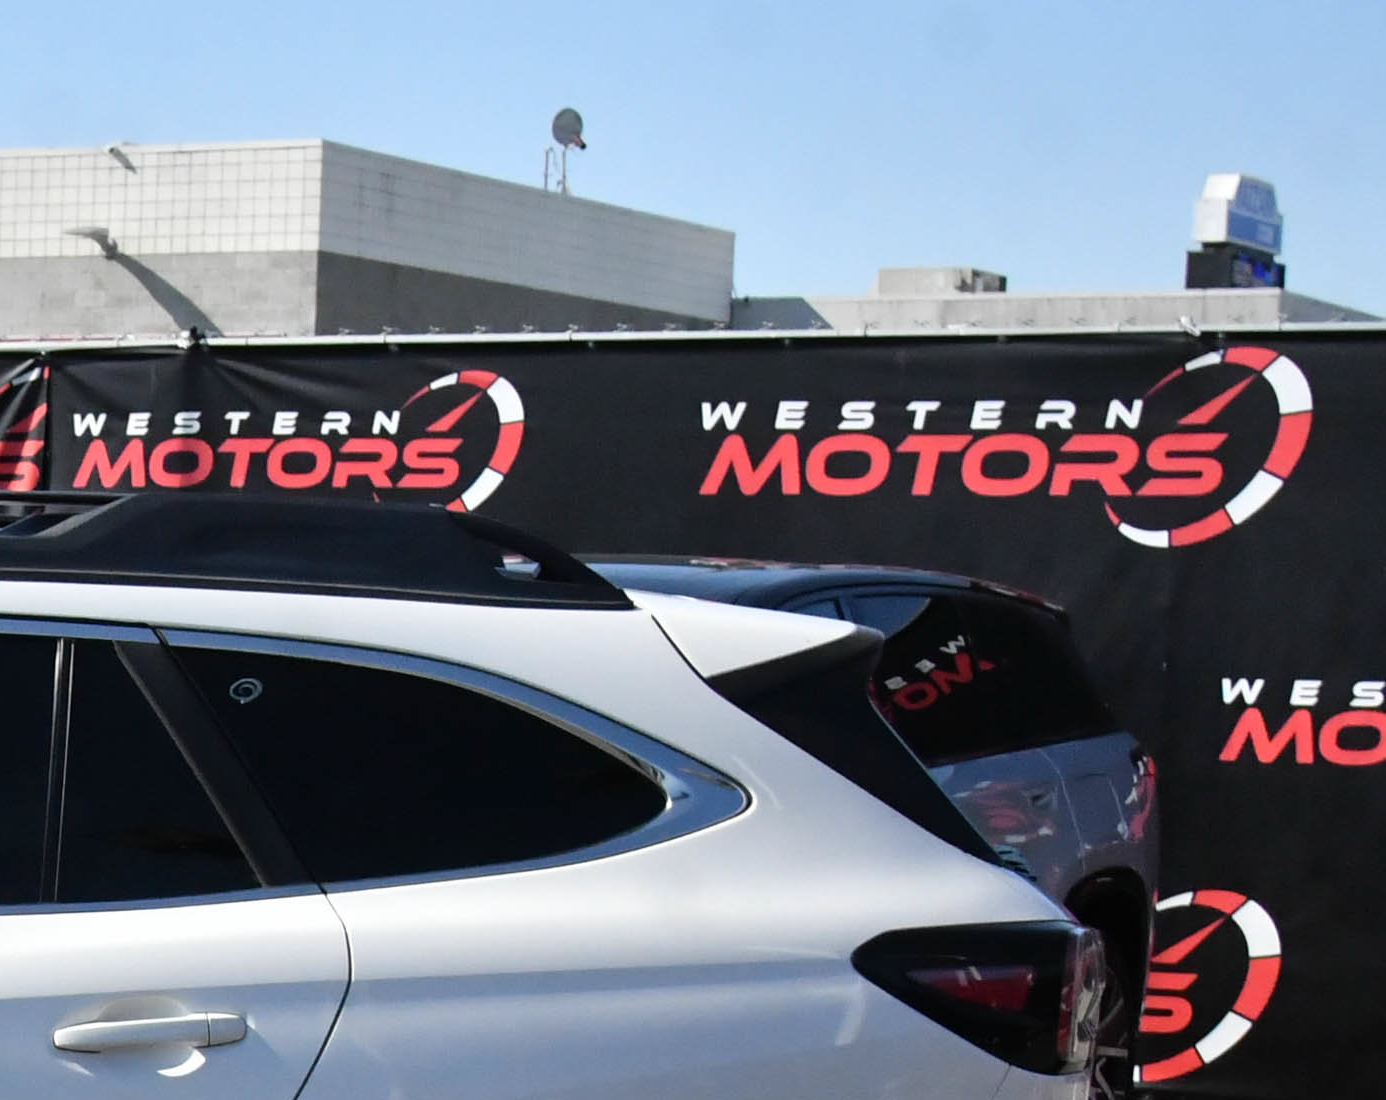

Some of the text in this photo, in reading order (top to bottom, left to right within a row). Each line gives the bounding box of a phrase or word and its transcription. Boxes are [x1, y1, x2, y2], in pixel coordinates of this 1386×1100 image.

[73, 410, 401, 436] WESTERN
[700, 400, 1144, 430] WESTERN
[72, 437, 464, 489] MOTORS
[698, 433, 1228, 497] MOTORS
[1221, 678, 1386, 707] WES
[1218, 708, 1386, 766] MO
